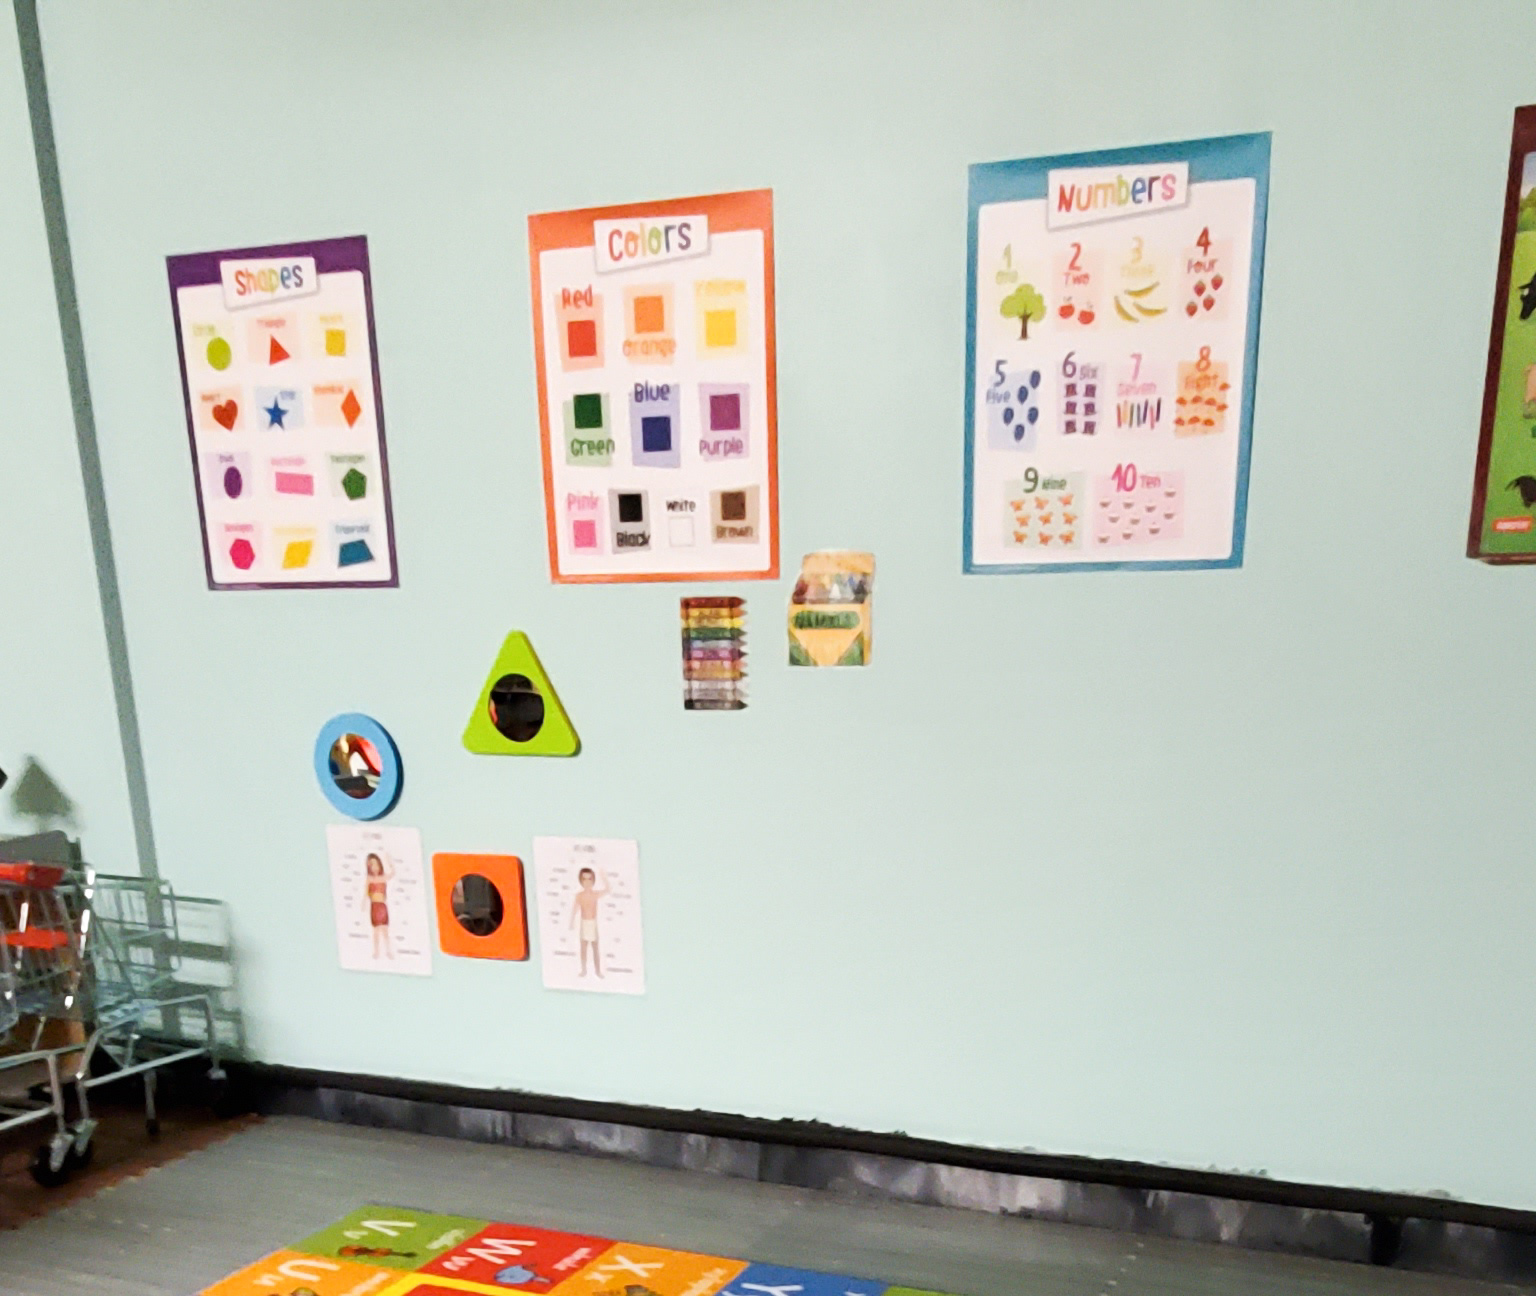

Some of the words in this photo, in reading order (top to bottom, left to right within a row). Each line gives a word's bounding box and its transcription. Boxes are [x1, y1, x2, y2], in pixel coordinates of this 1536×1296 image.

[1057, 172, 1177, 214] Numbers
[607, 222, 692, 262] Colors
[1130, 236, 1144, 265] 3
[1196, 226, 1213, 257] 4
[1001, 243, 1013, 269] 1
[1068, 242, 1084, 271] 2
[233, 264, 304, 297] Shapes
[561, 284, 594, 310] Red
[1062, 351, 1078, 379] 6
[1129, 353, 1144, 381] 7
[1195, 345, 1213, 373] 8
[994, 359, 1009, 388] 5
[633, 382, 671, 403] Blue
[570, 438, 616, 457] Green
[698, 438, 745, 457] Purple
[1023, 467, 1040, 494] 9
[1110, 462, 1138, 493] 10
